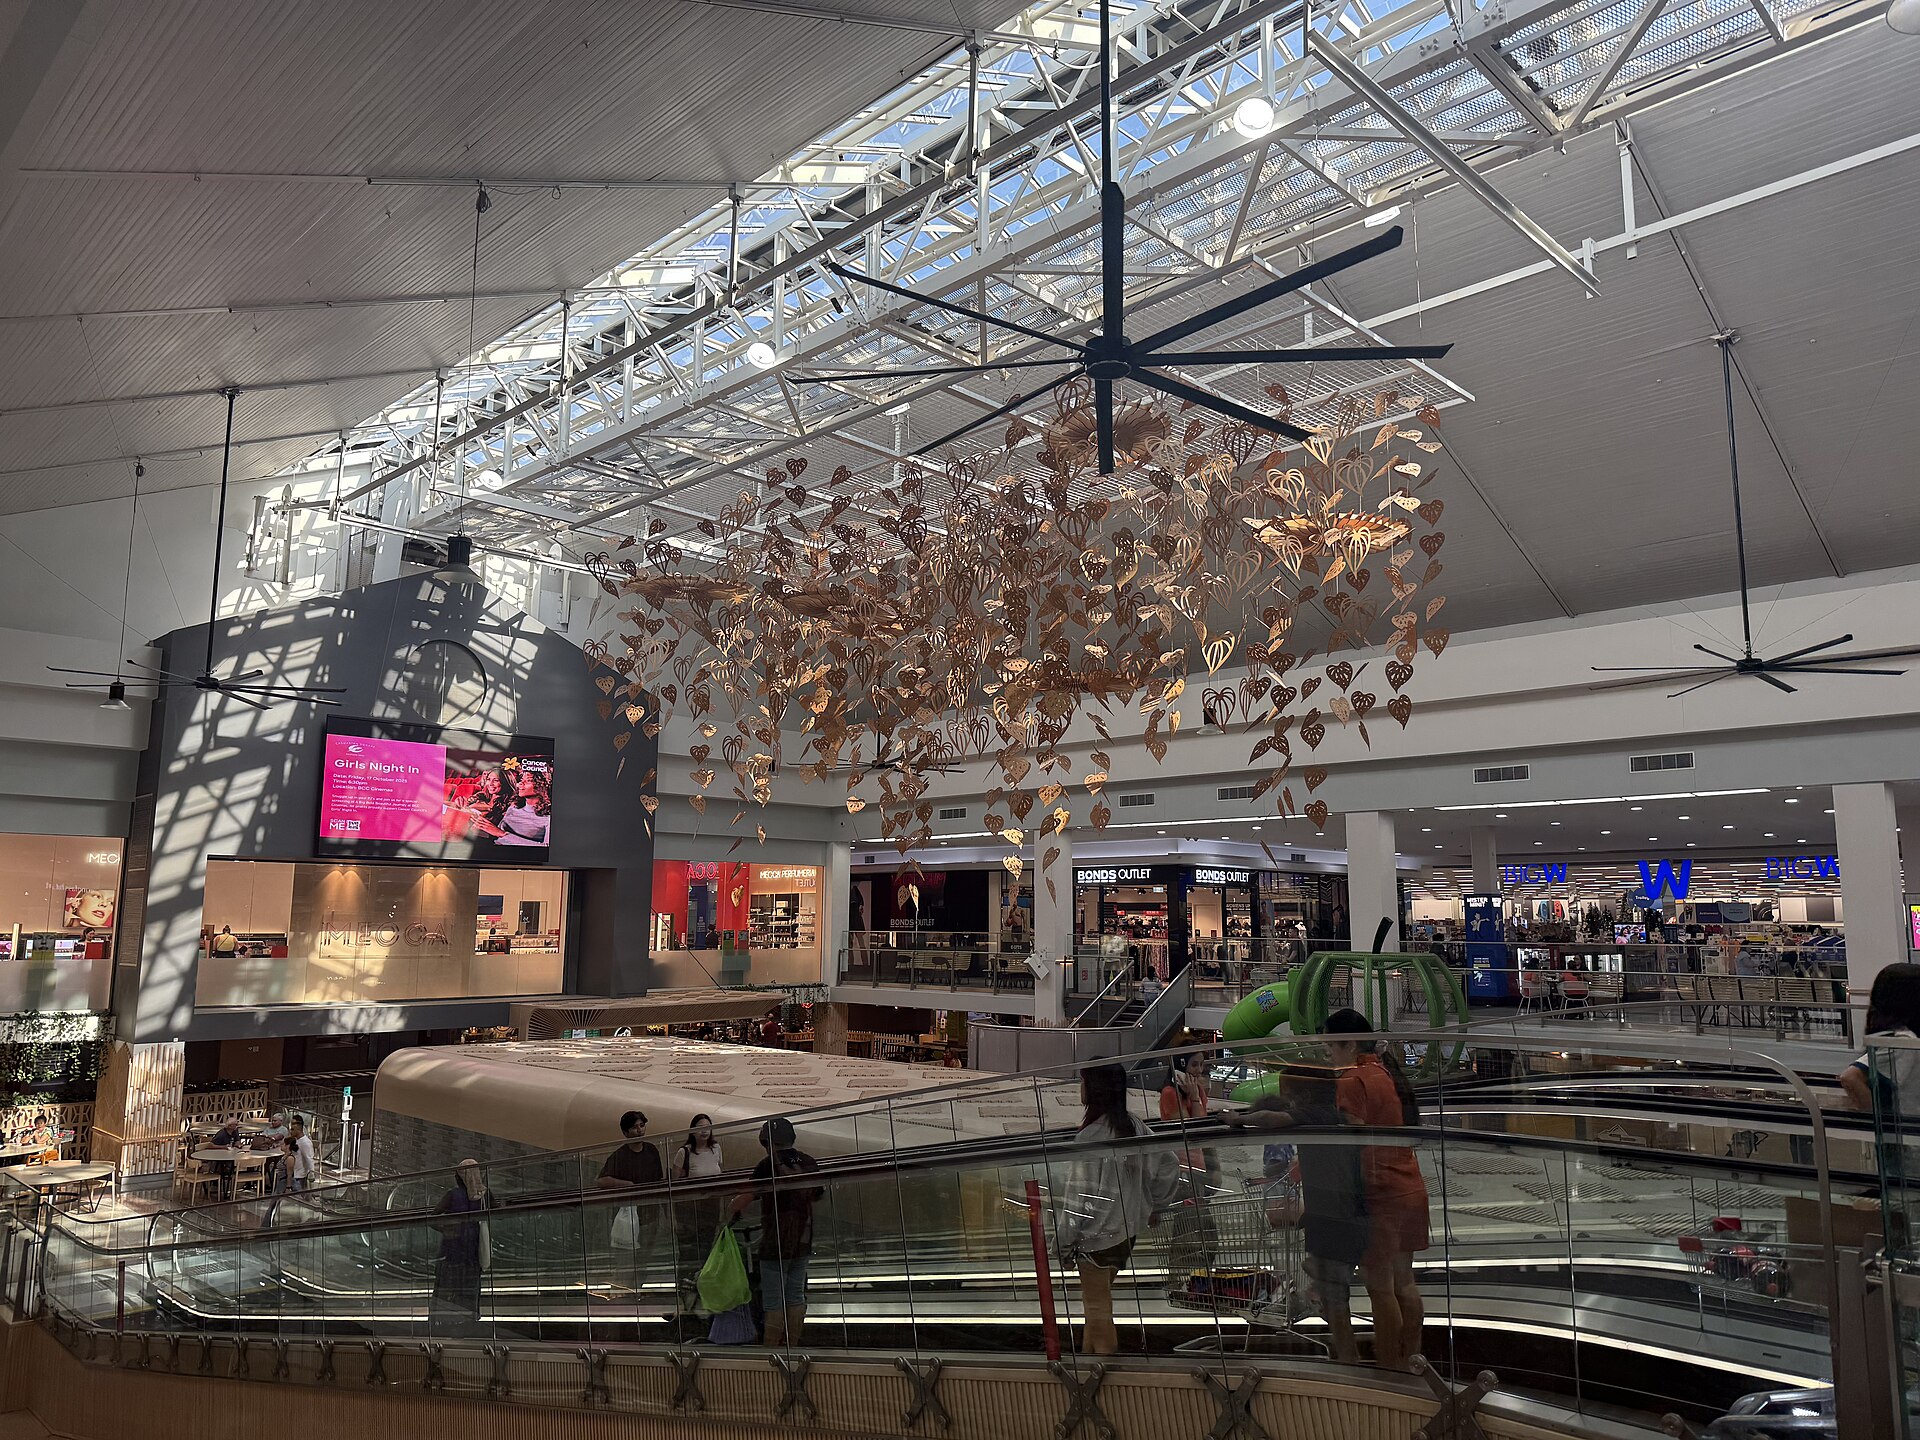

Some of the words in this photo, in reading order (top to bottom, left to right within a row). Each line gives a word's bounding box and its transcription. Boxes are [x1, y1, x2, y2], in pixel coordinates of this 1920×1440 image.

[334, 759, 366, 770] Girls
[369, 762, 405, 774] Night
[408, 765, 420, 774] In
[521, 758, 547, 767] Cancer
[521, 764, 548, 773] Council
[329, 822, 345, 831] ME
[88, 853, 121, 864] MEC
[760, 870, 781, 879] MECCA
[1077, 869, 1117, 881] BONDS
[1118, 868, 1152, 880] OUTLET
[1195, 869, 1226, 881] BONDS
[1226, 871, 1250, 883] OUTLET
[1637, 859, 1693, 900] W
[890, 918, 915, 927] BONDS
[915, 918, 935, 927] OUTLET
[323, 921, 449, 947] MECCA
